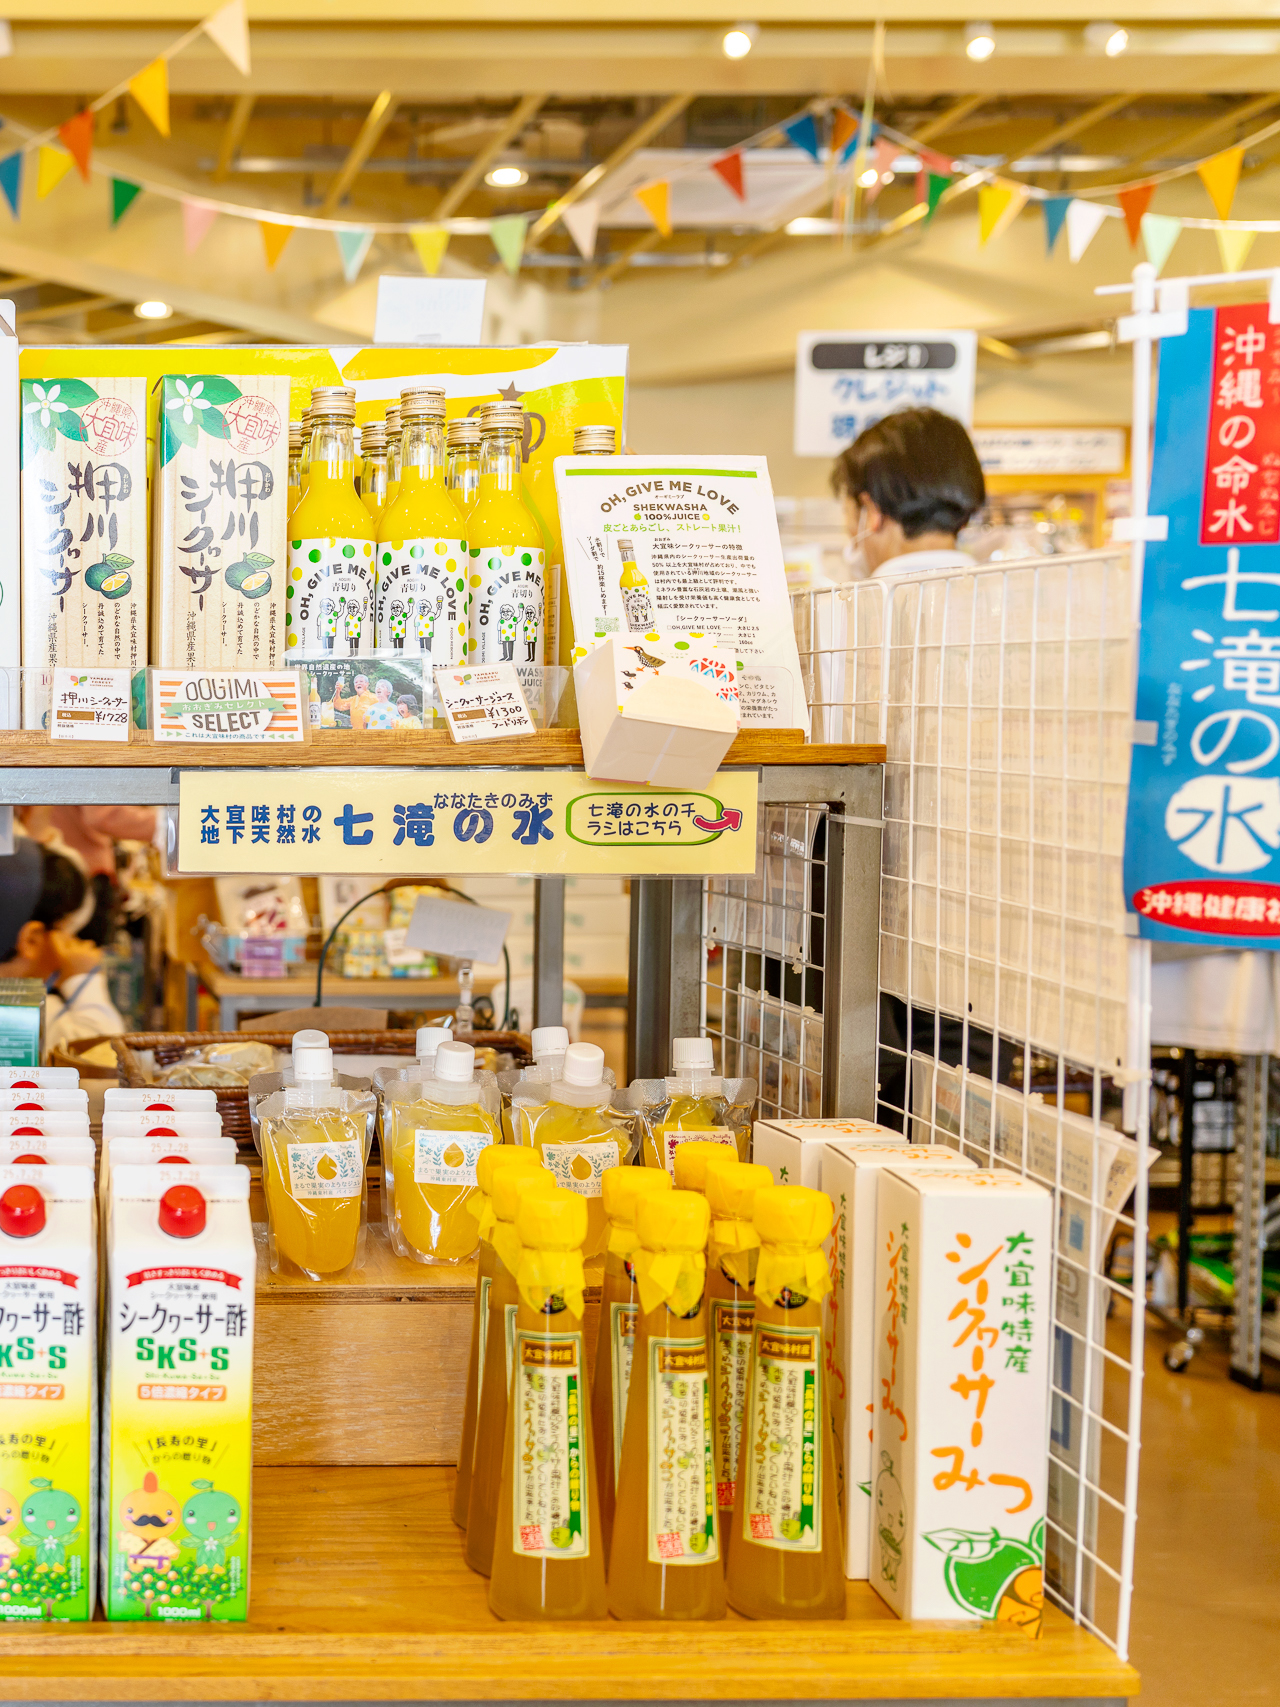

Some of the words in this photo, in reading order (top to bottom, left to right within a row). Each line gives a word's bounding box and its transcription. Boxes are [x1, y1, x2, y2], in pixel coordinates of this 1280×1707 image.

[1207, 324, 1266, 540] 沖縄の命水
[93, 438, 108, 454] 産
[236, 437, 249, 453] 産
[624, 480, 665, 498] GIVE
[669, 480, 693, 493] ME
[696, 484, 740, 516] LOVE
[633, 503, 708, 512] SHEKWASHA
[644, 512, 701, 521] 100%JUICE
[381, 564, 411, 593] GIVE
[416, 563, 440, 580] ME
[440, 576, 457, 622] LOVE
[486, 570, 522, 597] GIVE
[525, 571, 542, 587] ME
[185, 678, 259, 701] OOGIMI
[94, 711, 128, 724] ¥1728
[191, 711, 261, 733] SELECT
[486, 705, 522, 719] ¥1300
[433, 791, 554, 810] ななたきのみず
[200, 804, 322, 825] 大宜味村の
[587, 802, 696, 820] 七滝の水のチ
[200, 824, 322, 845] 地下天然水
[333, 803, 555, 848] 七滝の水
[585, 819, 683, 837] ラシはこちら
[8, 1069, 41, 1079] 25.7.28
[11, 1092, 45, 1102] 25.7.28
[141, 1093, 176, 1103] 25.7.28
[140, 1115, 176, 1126] 25.7.28
[1002, 1231, 1036, 1374] 大宜味特産
[119, 1302, 248, 1337] シークヮーサー酢
[881, 1377, 909, 1442] みつ
[931, 1445, 1034, 1515] みつ
